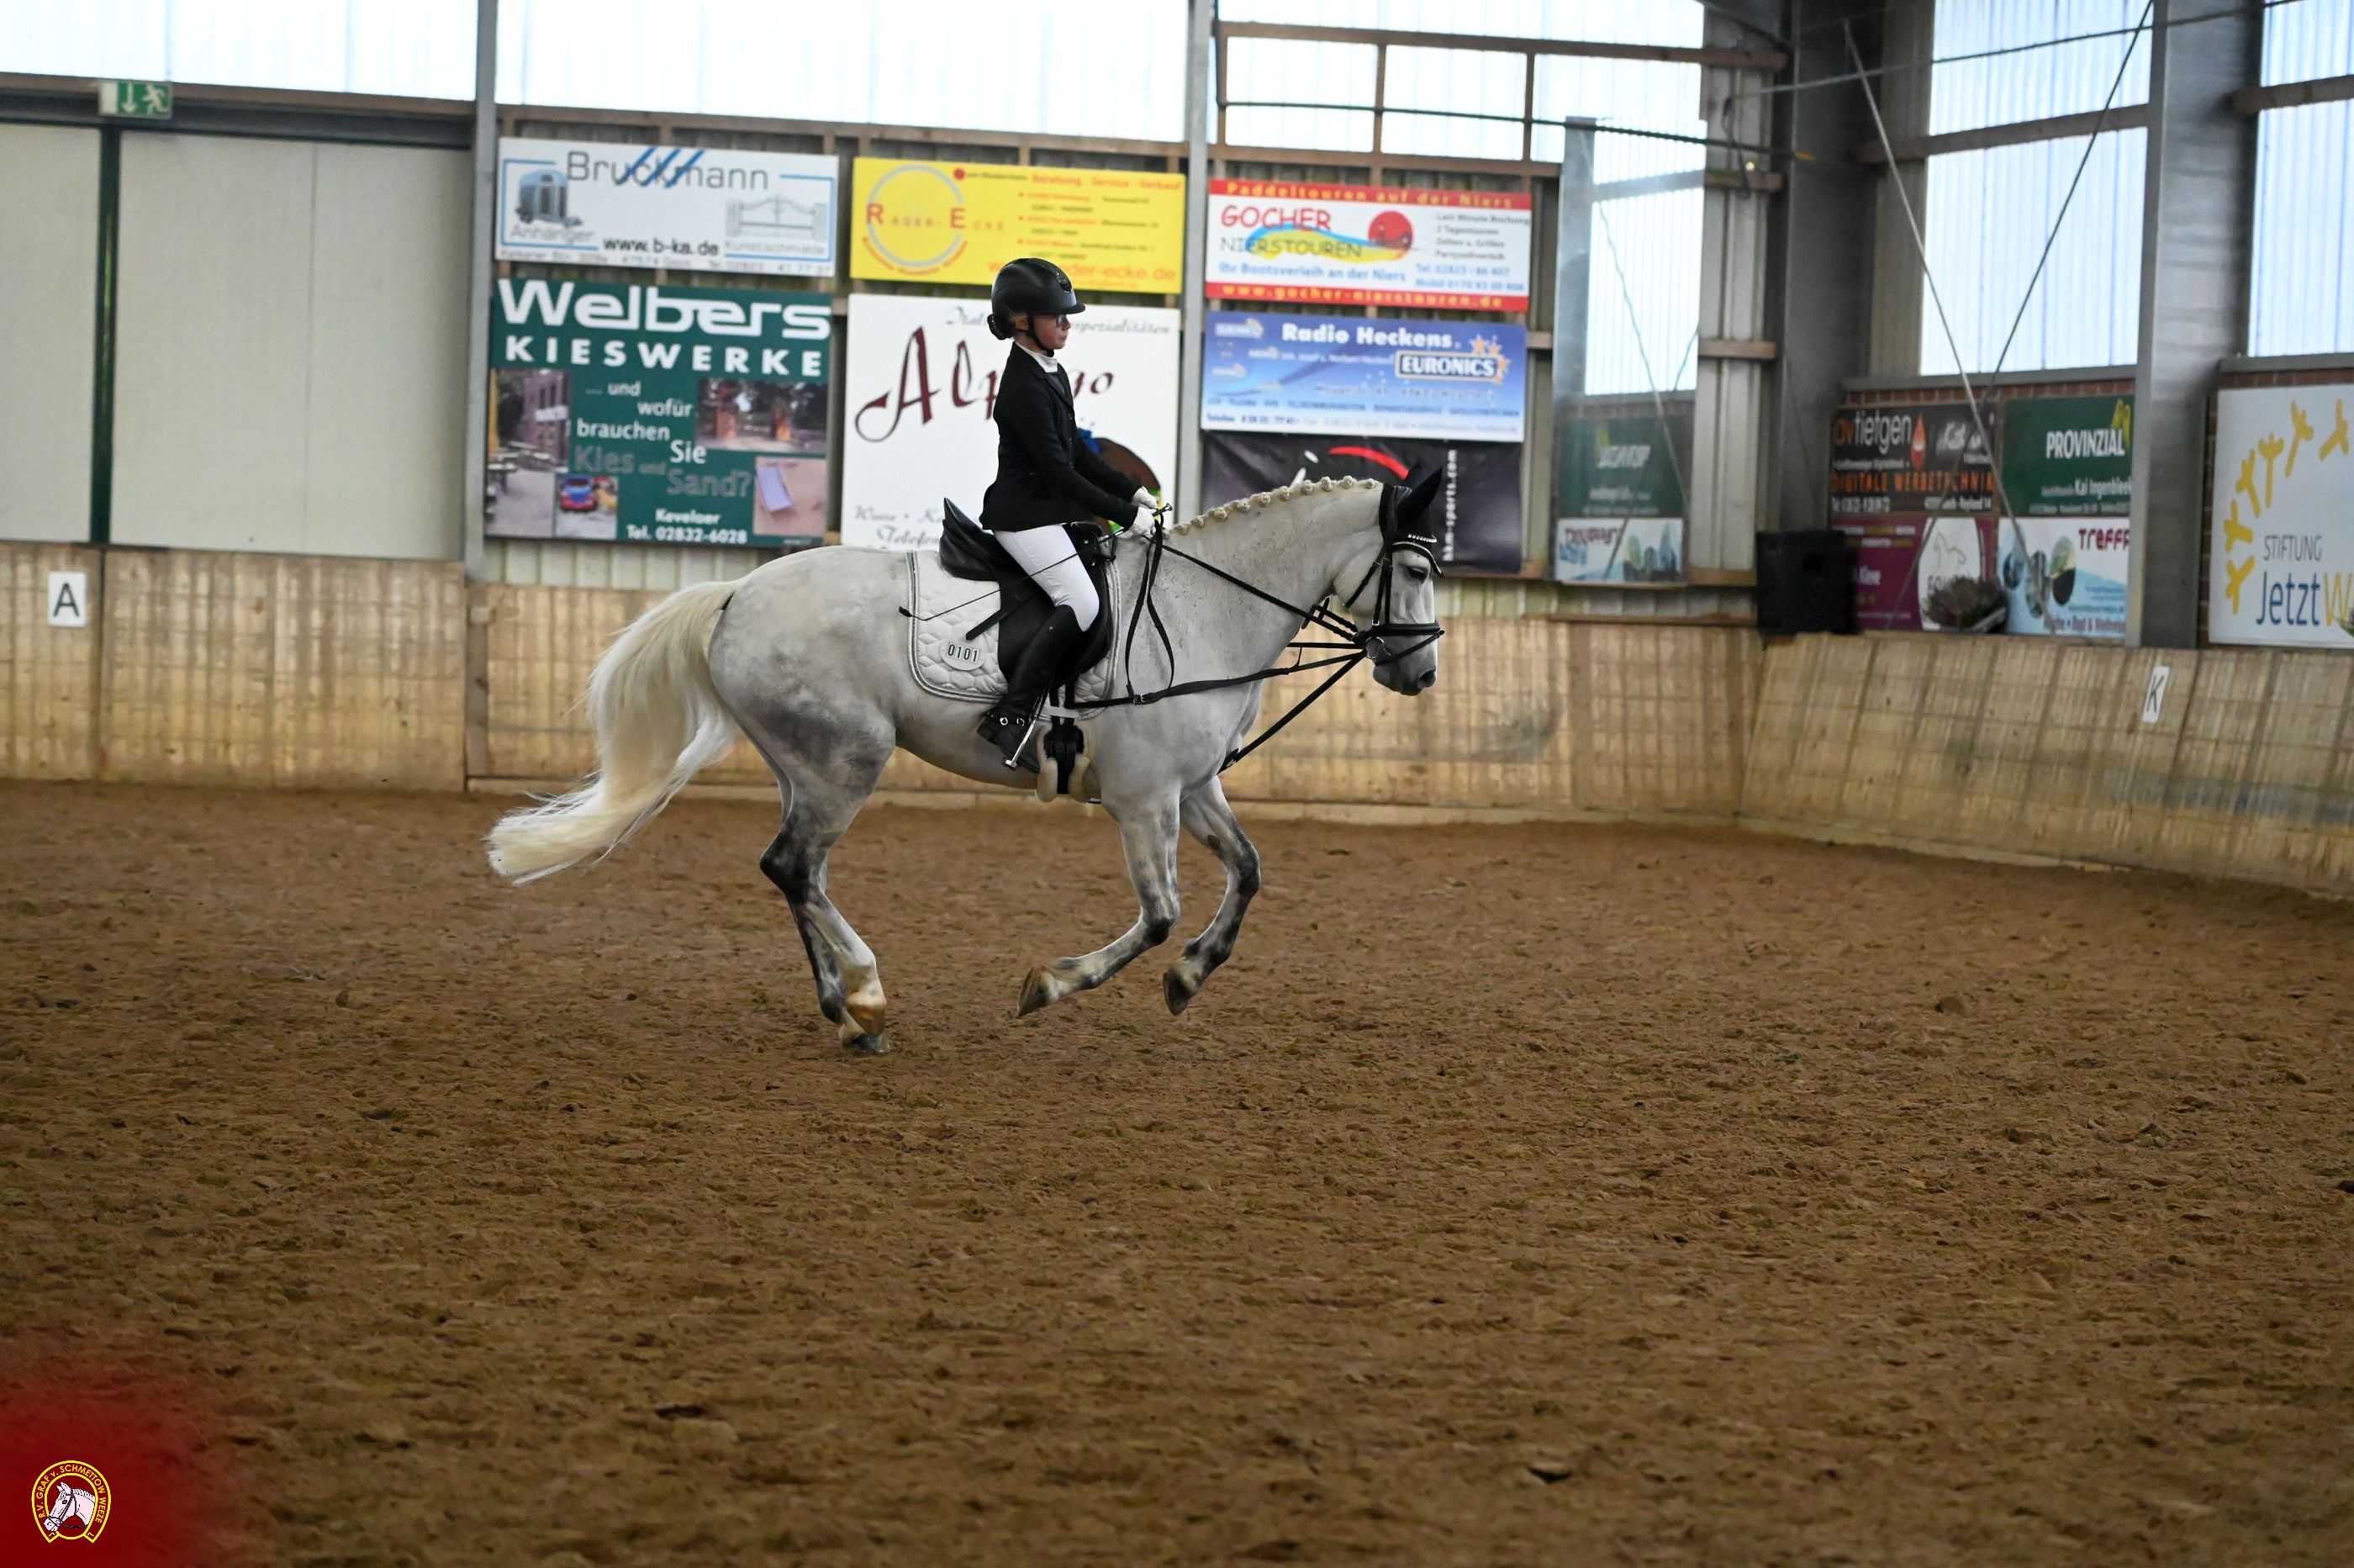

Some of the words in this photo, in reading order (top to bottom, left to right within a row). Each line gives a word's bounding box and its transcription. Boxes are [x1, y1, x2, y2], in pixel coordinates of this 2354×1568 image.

[1227, 182, 1367, 200] Paddeltouren
[1376, 191, 1408, 203] auf
[1417, 193, 1449, 205] der
[1459, 194, 1512, 208] Niers
[1221, 204, 1332, 231] GOCHER
[1220, 236, 1363, 257] NIERSTOUREN
[1220, 262, 1238, 272] Ihr
[1327, 268, 1344, 277] an
[1347, 268, 1368, 279] der
[497, 278, 832, 341] Welbers
[1281, 322, 1350, 344] Radio
[1356, 325, 1453, 349] Heckens
[505, 335, 822, 377] KIESWERKE
[1401, 355, 1496, 377] EURONICS
[607, 381, 641, 397] und
[637, 398, 693, 418] wofür
[577, 417, 671, 441] brauchen
[670, 439, 708, 464] Sie
[2045, 429, 2125, 460] PROVINZIAL
[574, 444, 636, 473] Kies
[667, 467, 752, 498] Sand?
[626, 525, 651, 540] Tel.
[53, 582, 80, 617] A
[947, 644, 979, 663] 0101
[2146, 676, 2165, 714] K
